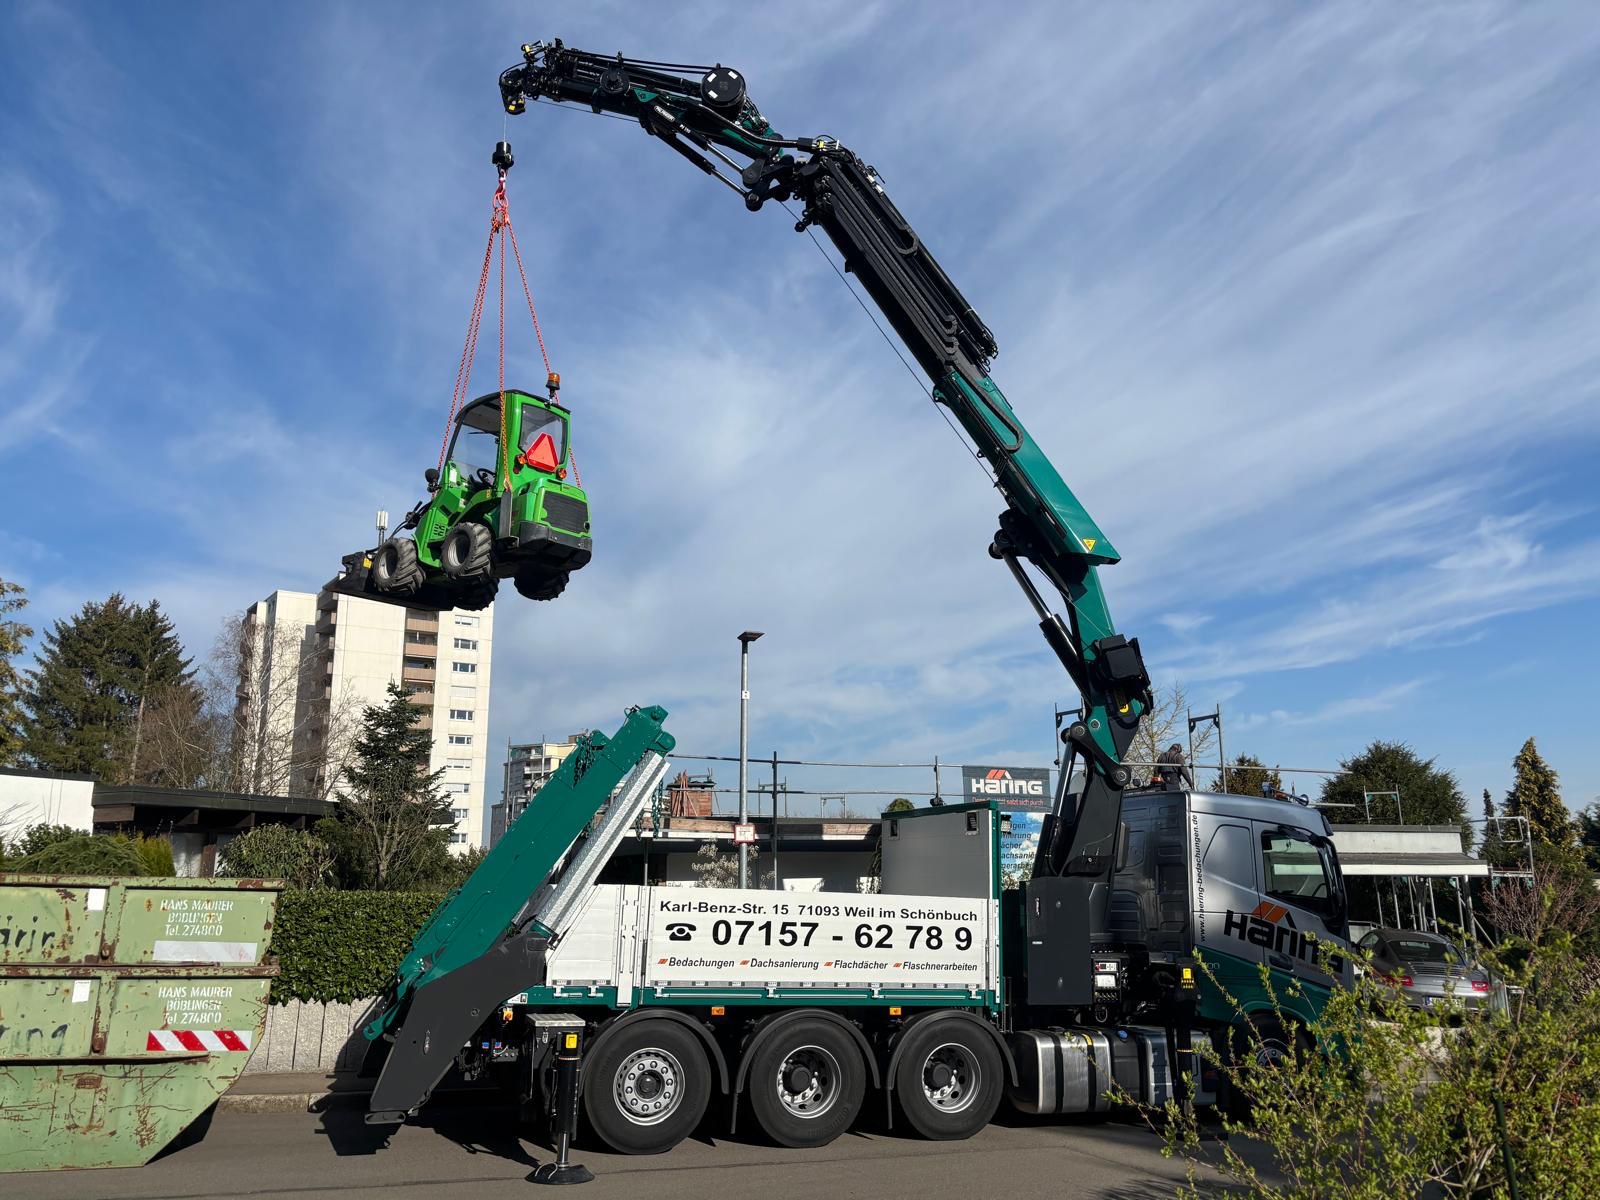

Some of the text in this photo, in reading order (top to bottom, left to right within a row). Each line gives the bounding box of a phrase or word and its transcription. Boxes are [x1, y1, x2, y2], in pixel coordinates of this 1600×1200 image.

[1191, 814, 1206, 943] www.haering-bedachungen.de
[160, 899, 234, 911] HANS MAURER
[659, 900, 978, 921] Karl-Benz-Str. 15 71093 Weil im Schönbuch
[712, 919, 819, 947] 07157
[854, 923, 893, 949] 62
[905, 925, 943, 950] 78
[954, 926, 972, 950] 9
[668, 957, 978, 971] Bedachungen Dachsanierung Flachdächer Flaschnerarbeiten
[158, 986, 233, 998] HANS MAURER
[166, 998, 223, 1011] BÖBLINGEN
